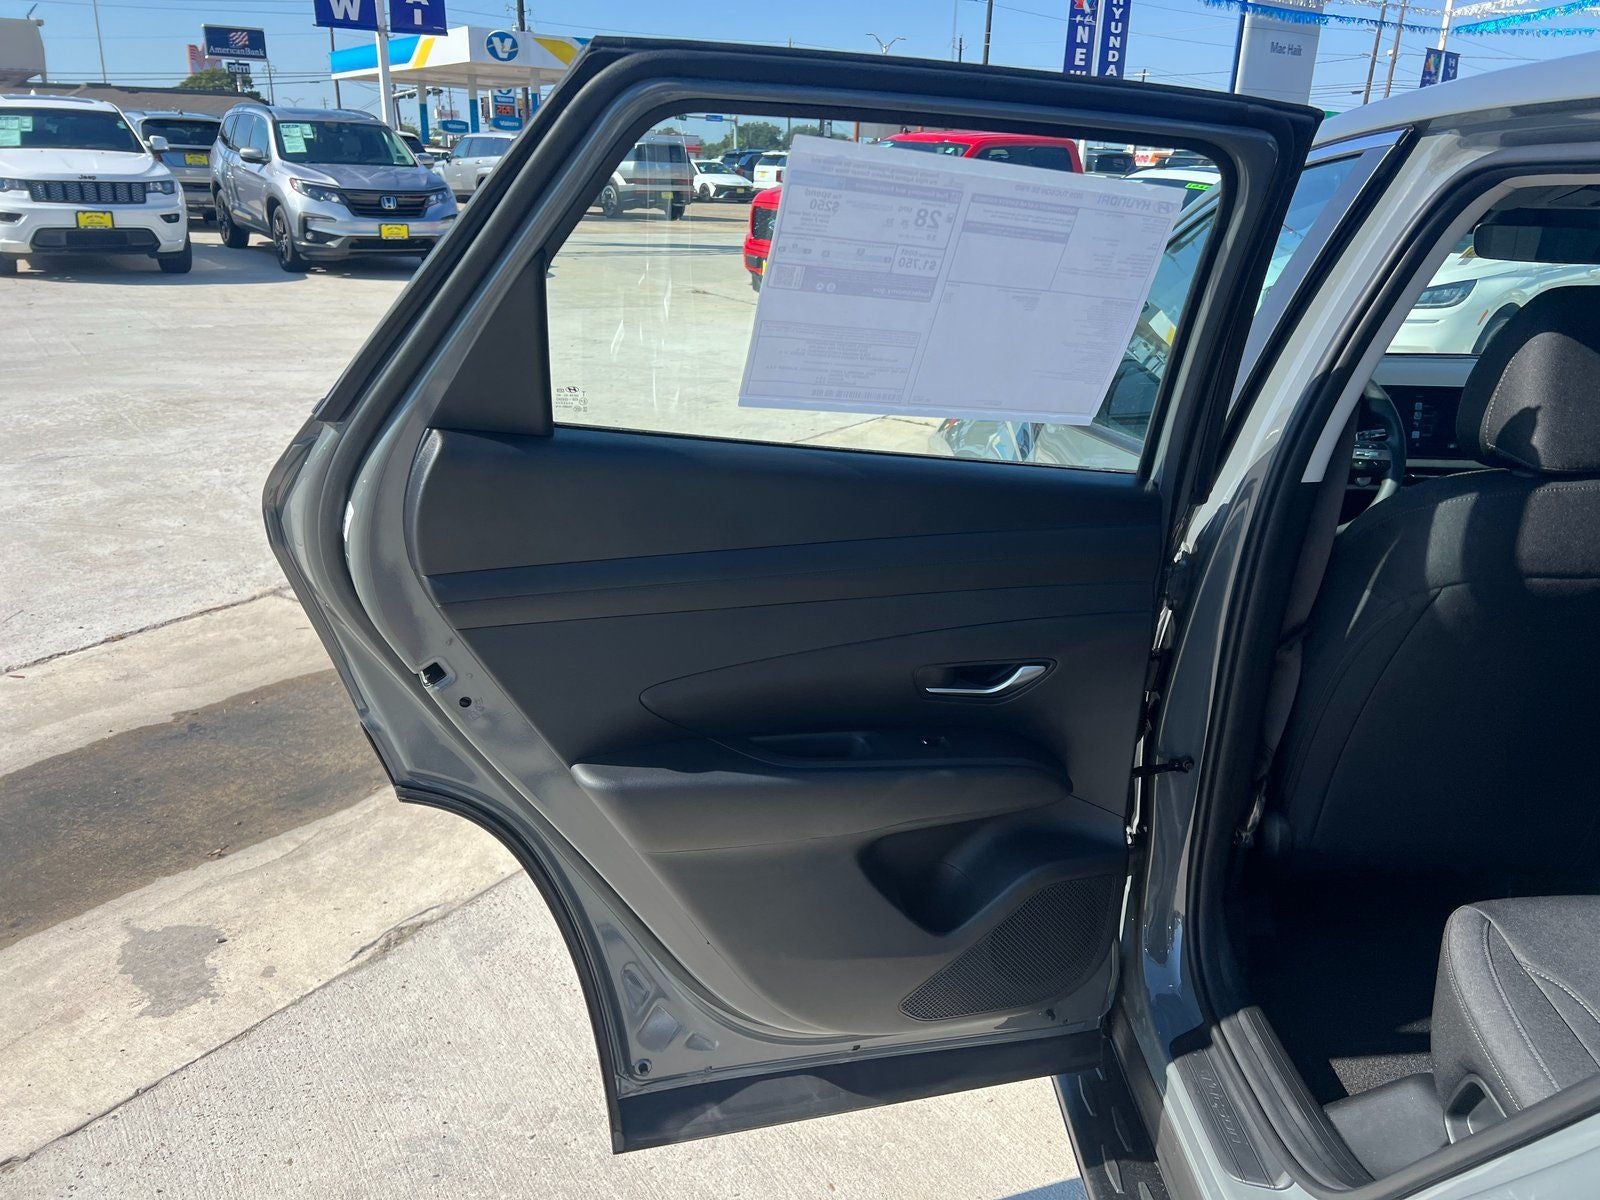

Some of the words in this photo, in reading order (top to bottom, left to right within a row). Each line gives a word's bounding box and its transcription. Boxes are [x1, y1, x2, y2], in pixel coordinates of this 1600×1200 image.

[209, 45, 265, 56] AmericanBank
[1070, 26, 1089, 75] NE
[1270, 41, 1286, 54] Mac
[1287, 44, 1302, 56] Haik
[228, 64, 249, 73] atm
